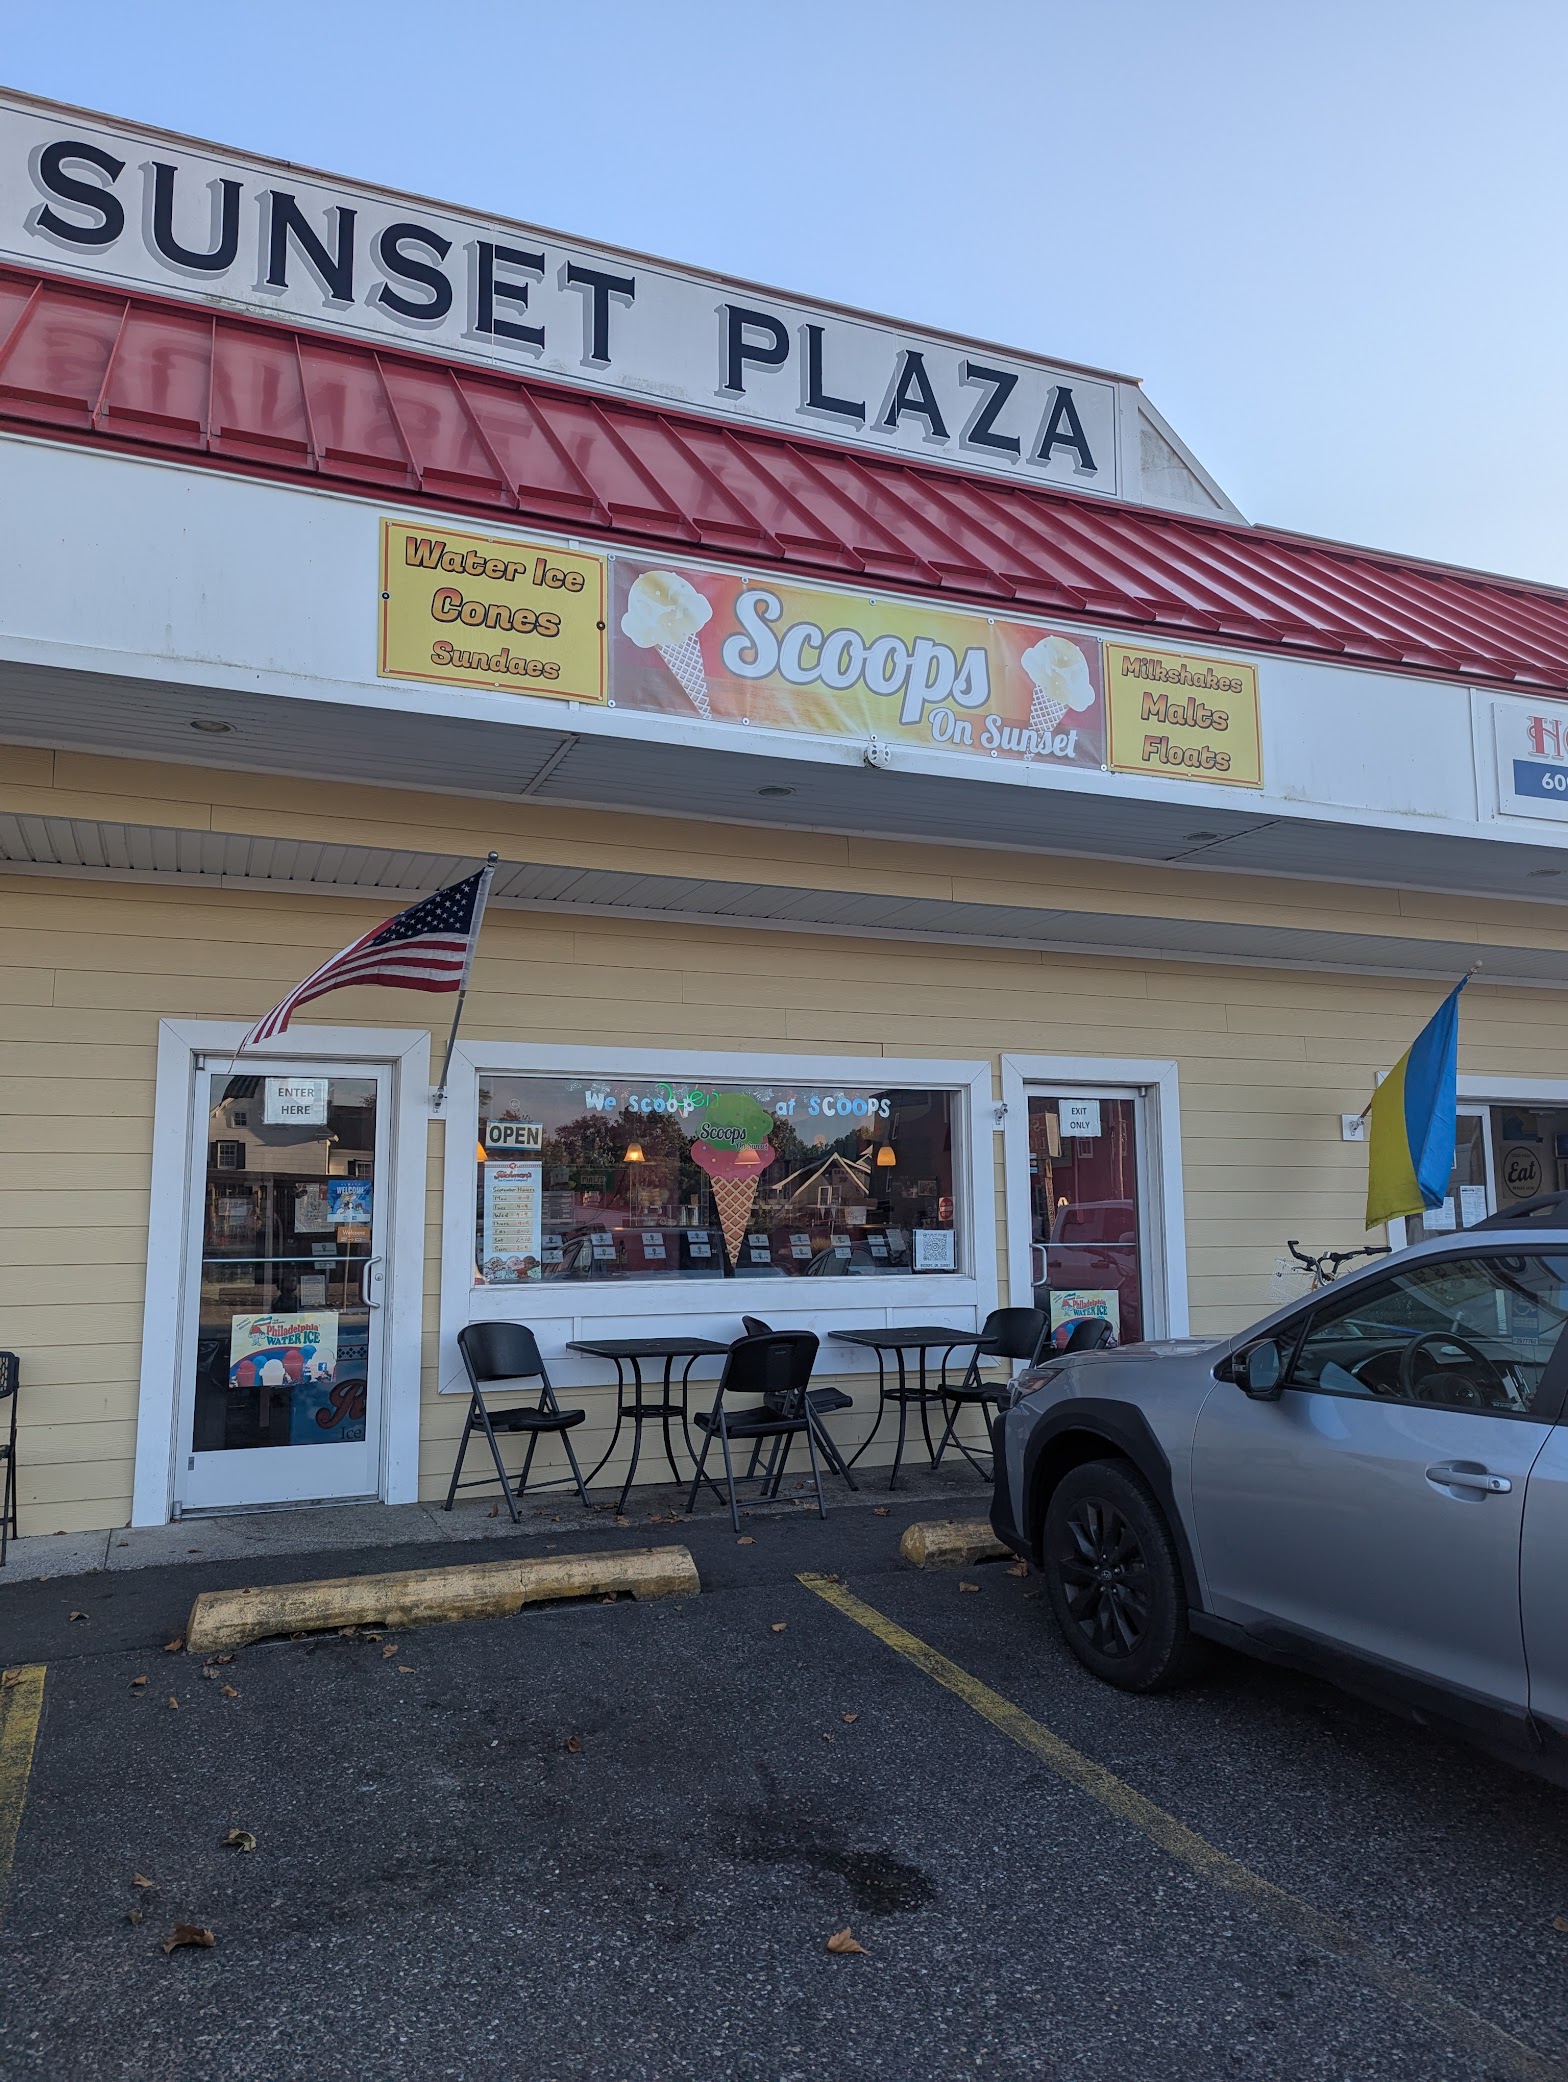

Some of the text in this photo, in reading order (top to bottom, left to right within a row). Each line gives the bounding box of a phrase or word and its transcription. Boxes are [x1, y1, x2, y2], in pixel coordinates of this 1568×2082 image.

[30, 140, 1099, 475] SUNSET PLAZA
[405, 535, 585, 594] Water Ice
[431, 587, 562, 638] Cones
[431, 640, 560, 680] Sundaes
[721, 587, 991, 726] Scoops
[1121, 655, 1243, 694] Milkshakes
[1140, 691, 1229, 732] Malts
[927, 706, 1078, 759] On Sunset
[1141, 734, 1232, 772] Floats
[278, 1087, 315, 1098] ENTER
[585, 1090, 616, 1111] We
[775, 1098, 796, 1116] at
[807, 1095, 892, 1118] SCOOPS
[281, 1105, 310, 1115] HERE
[1071, 1107, 1087, 1115] EXIT
[489, 1125, 539, 1145] OPEN
[700, 1122, 747, 1145] Scoops
[1069, 1121, 1090, 1129] ONLY
[1507, 1160, 1536, 1183] Eat
[1072, 1299, 1107, 1310] Philadelphia
[1073, 1304, 1108, 1317] WATER ICE
[266, 1323, 319, 1337] Philadelphia
[266, 1330, 321, 1346] WATER ICE
[341, 1426, 362, 1440] Ice
